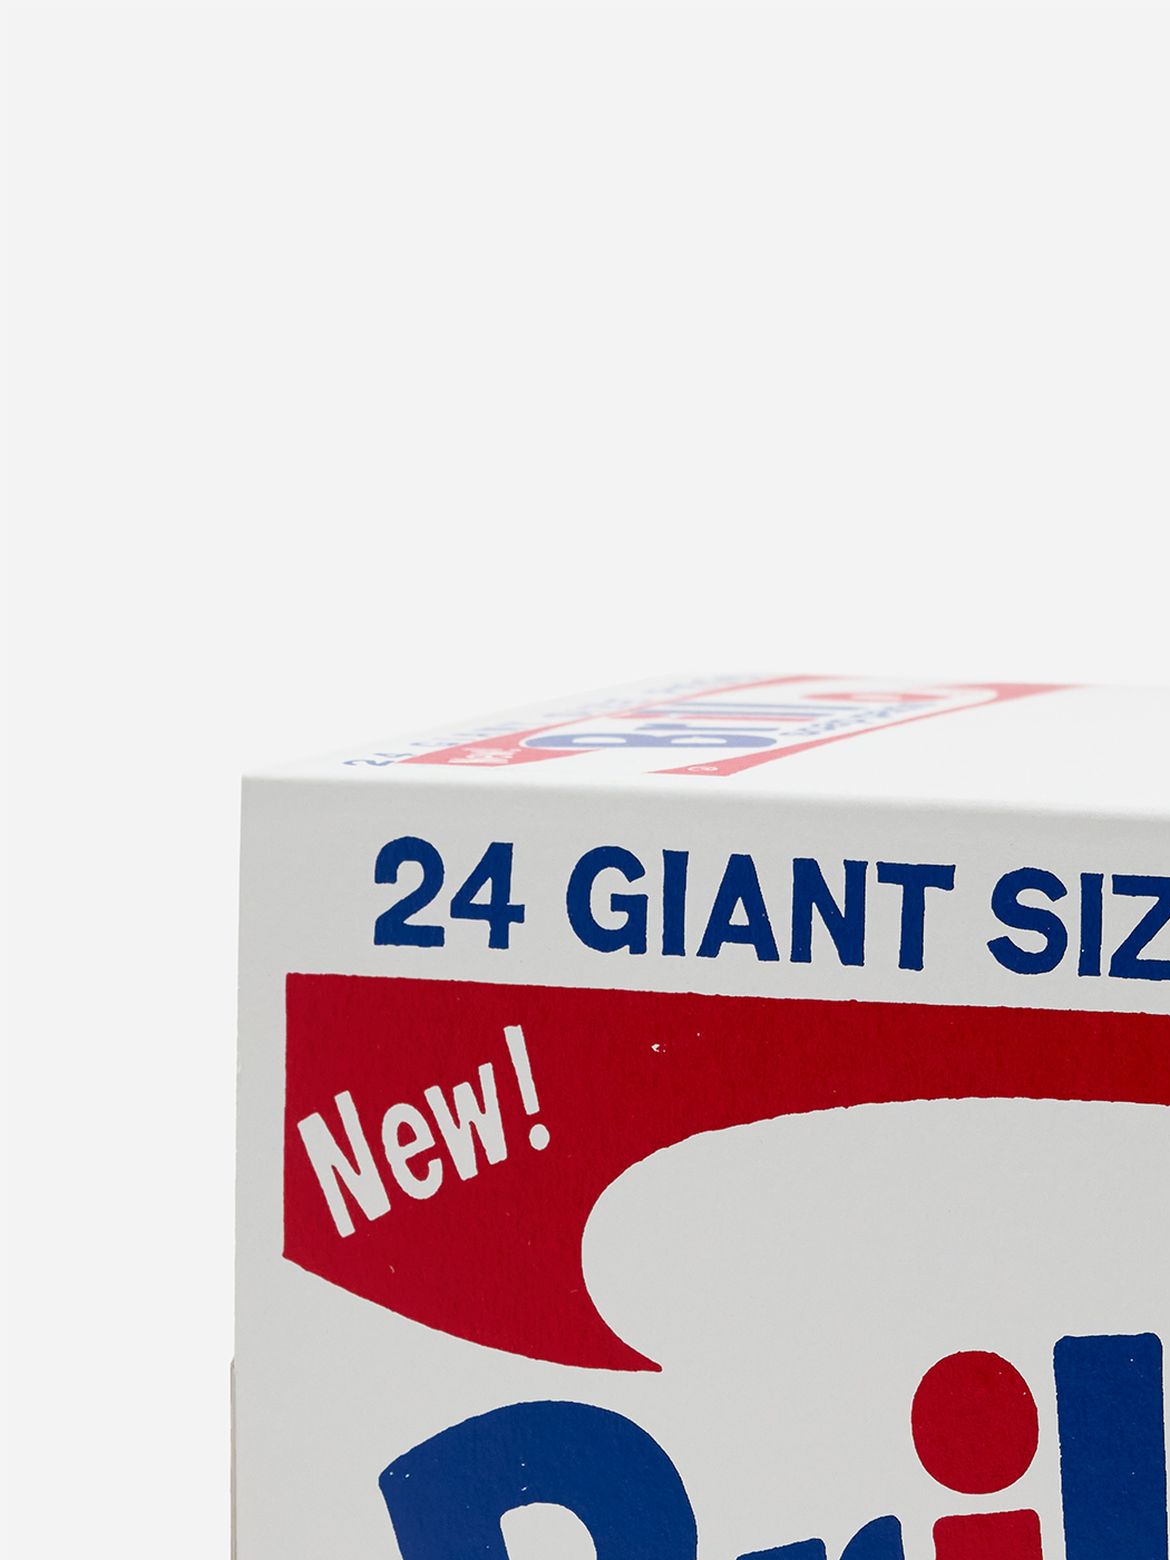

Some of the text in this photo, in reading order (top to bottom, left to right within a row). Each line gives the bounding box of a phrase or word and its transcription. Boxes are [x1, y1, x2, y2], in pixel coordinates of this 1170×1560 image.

[373, 835, 526, 950] 24
[565, 845, 956, 972] GIANT
[296, 1024, 551, 1239] New!
